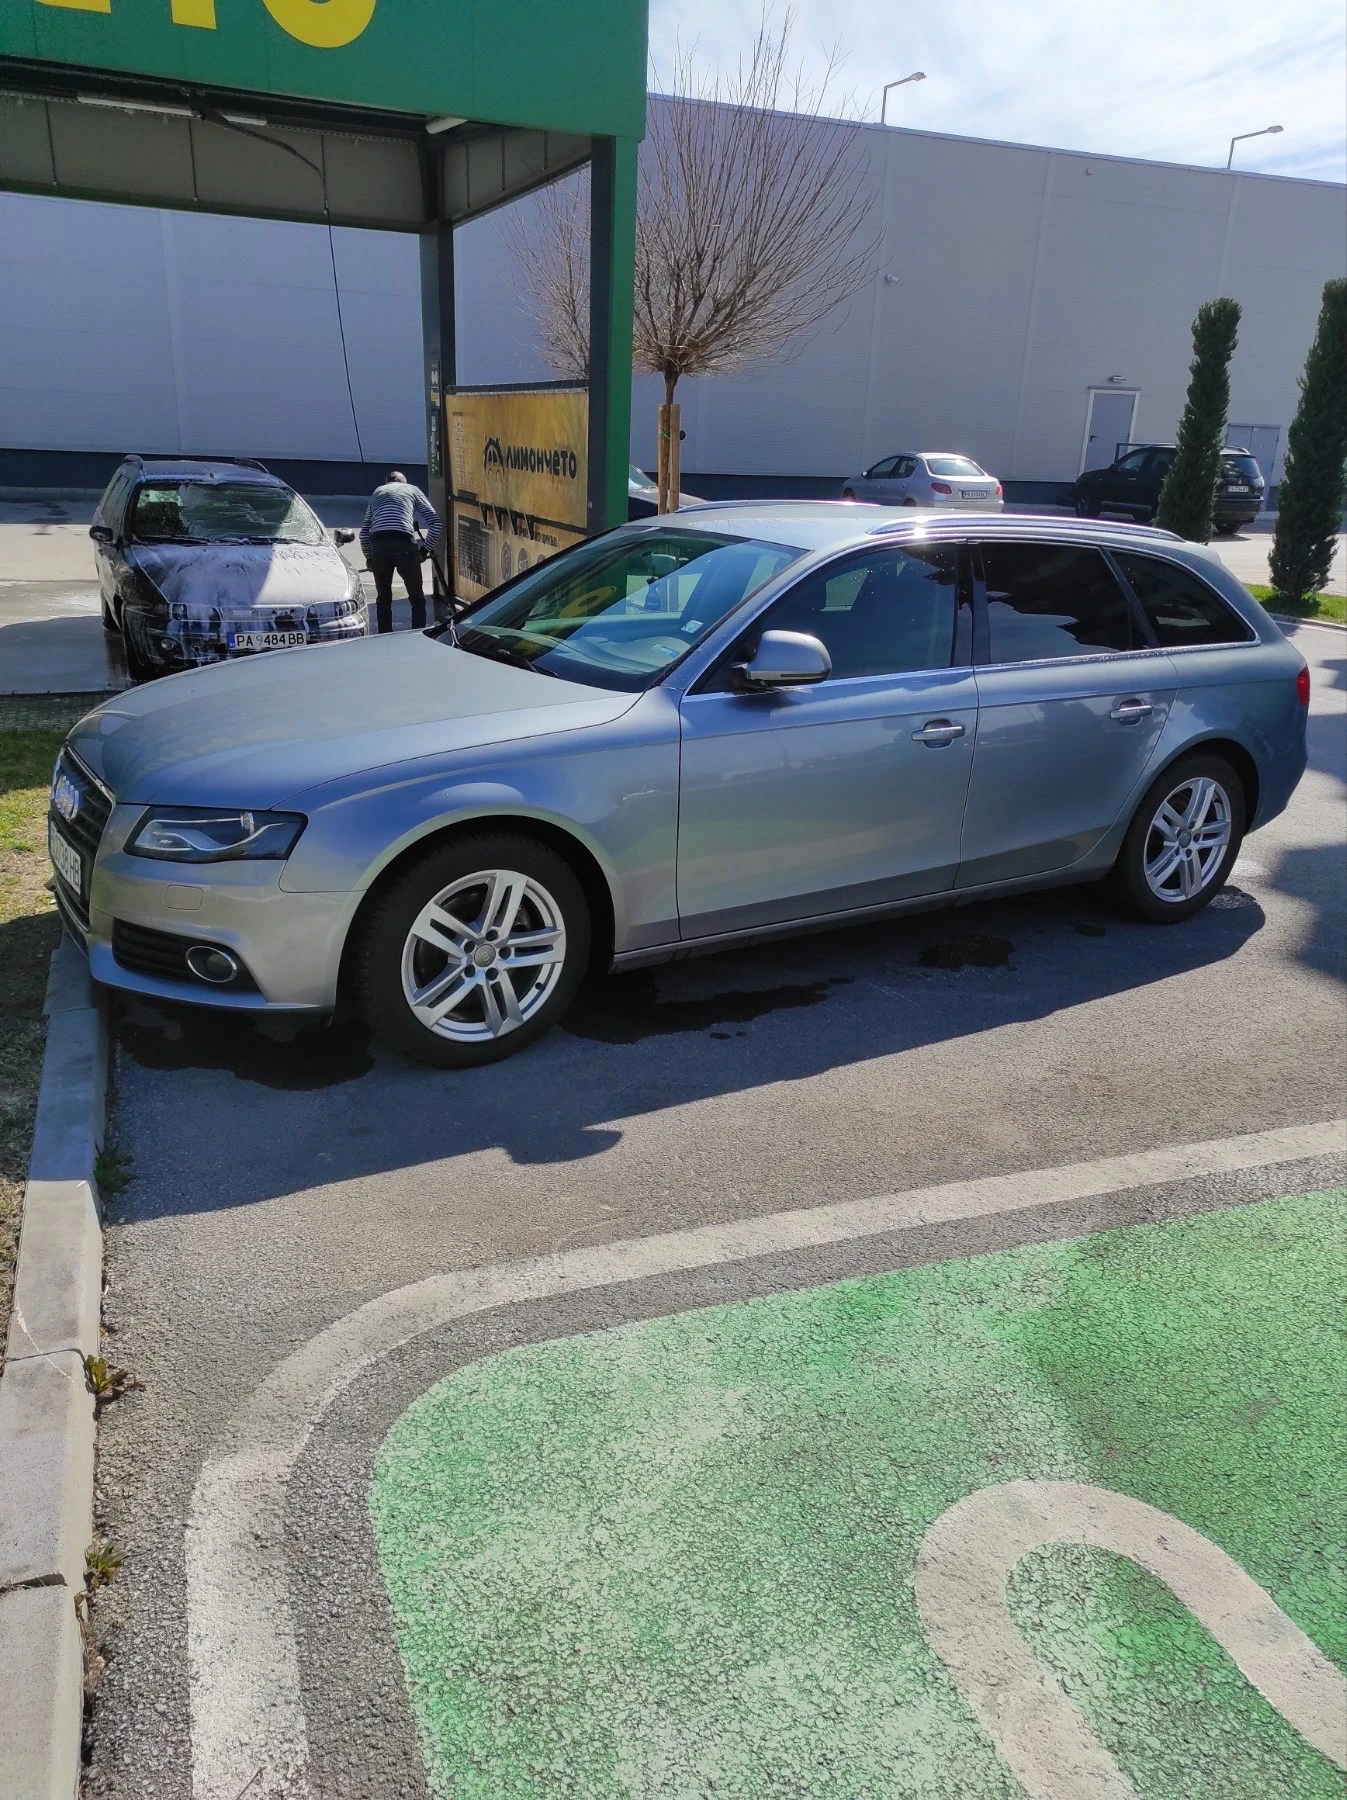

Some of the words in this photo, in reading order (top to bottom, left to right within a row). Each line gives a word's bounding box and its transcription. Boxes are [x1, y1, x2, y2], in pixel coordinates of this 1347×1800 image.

[236, 635, 254, 647] PA
[255, 633, 286, 646] 9484
[288, 632, 304, 645] BB
